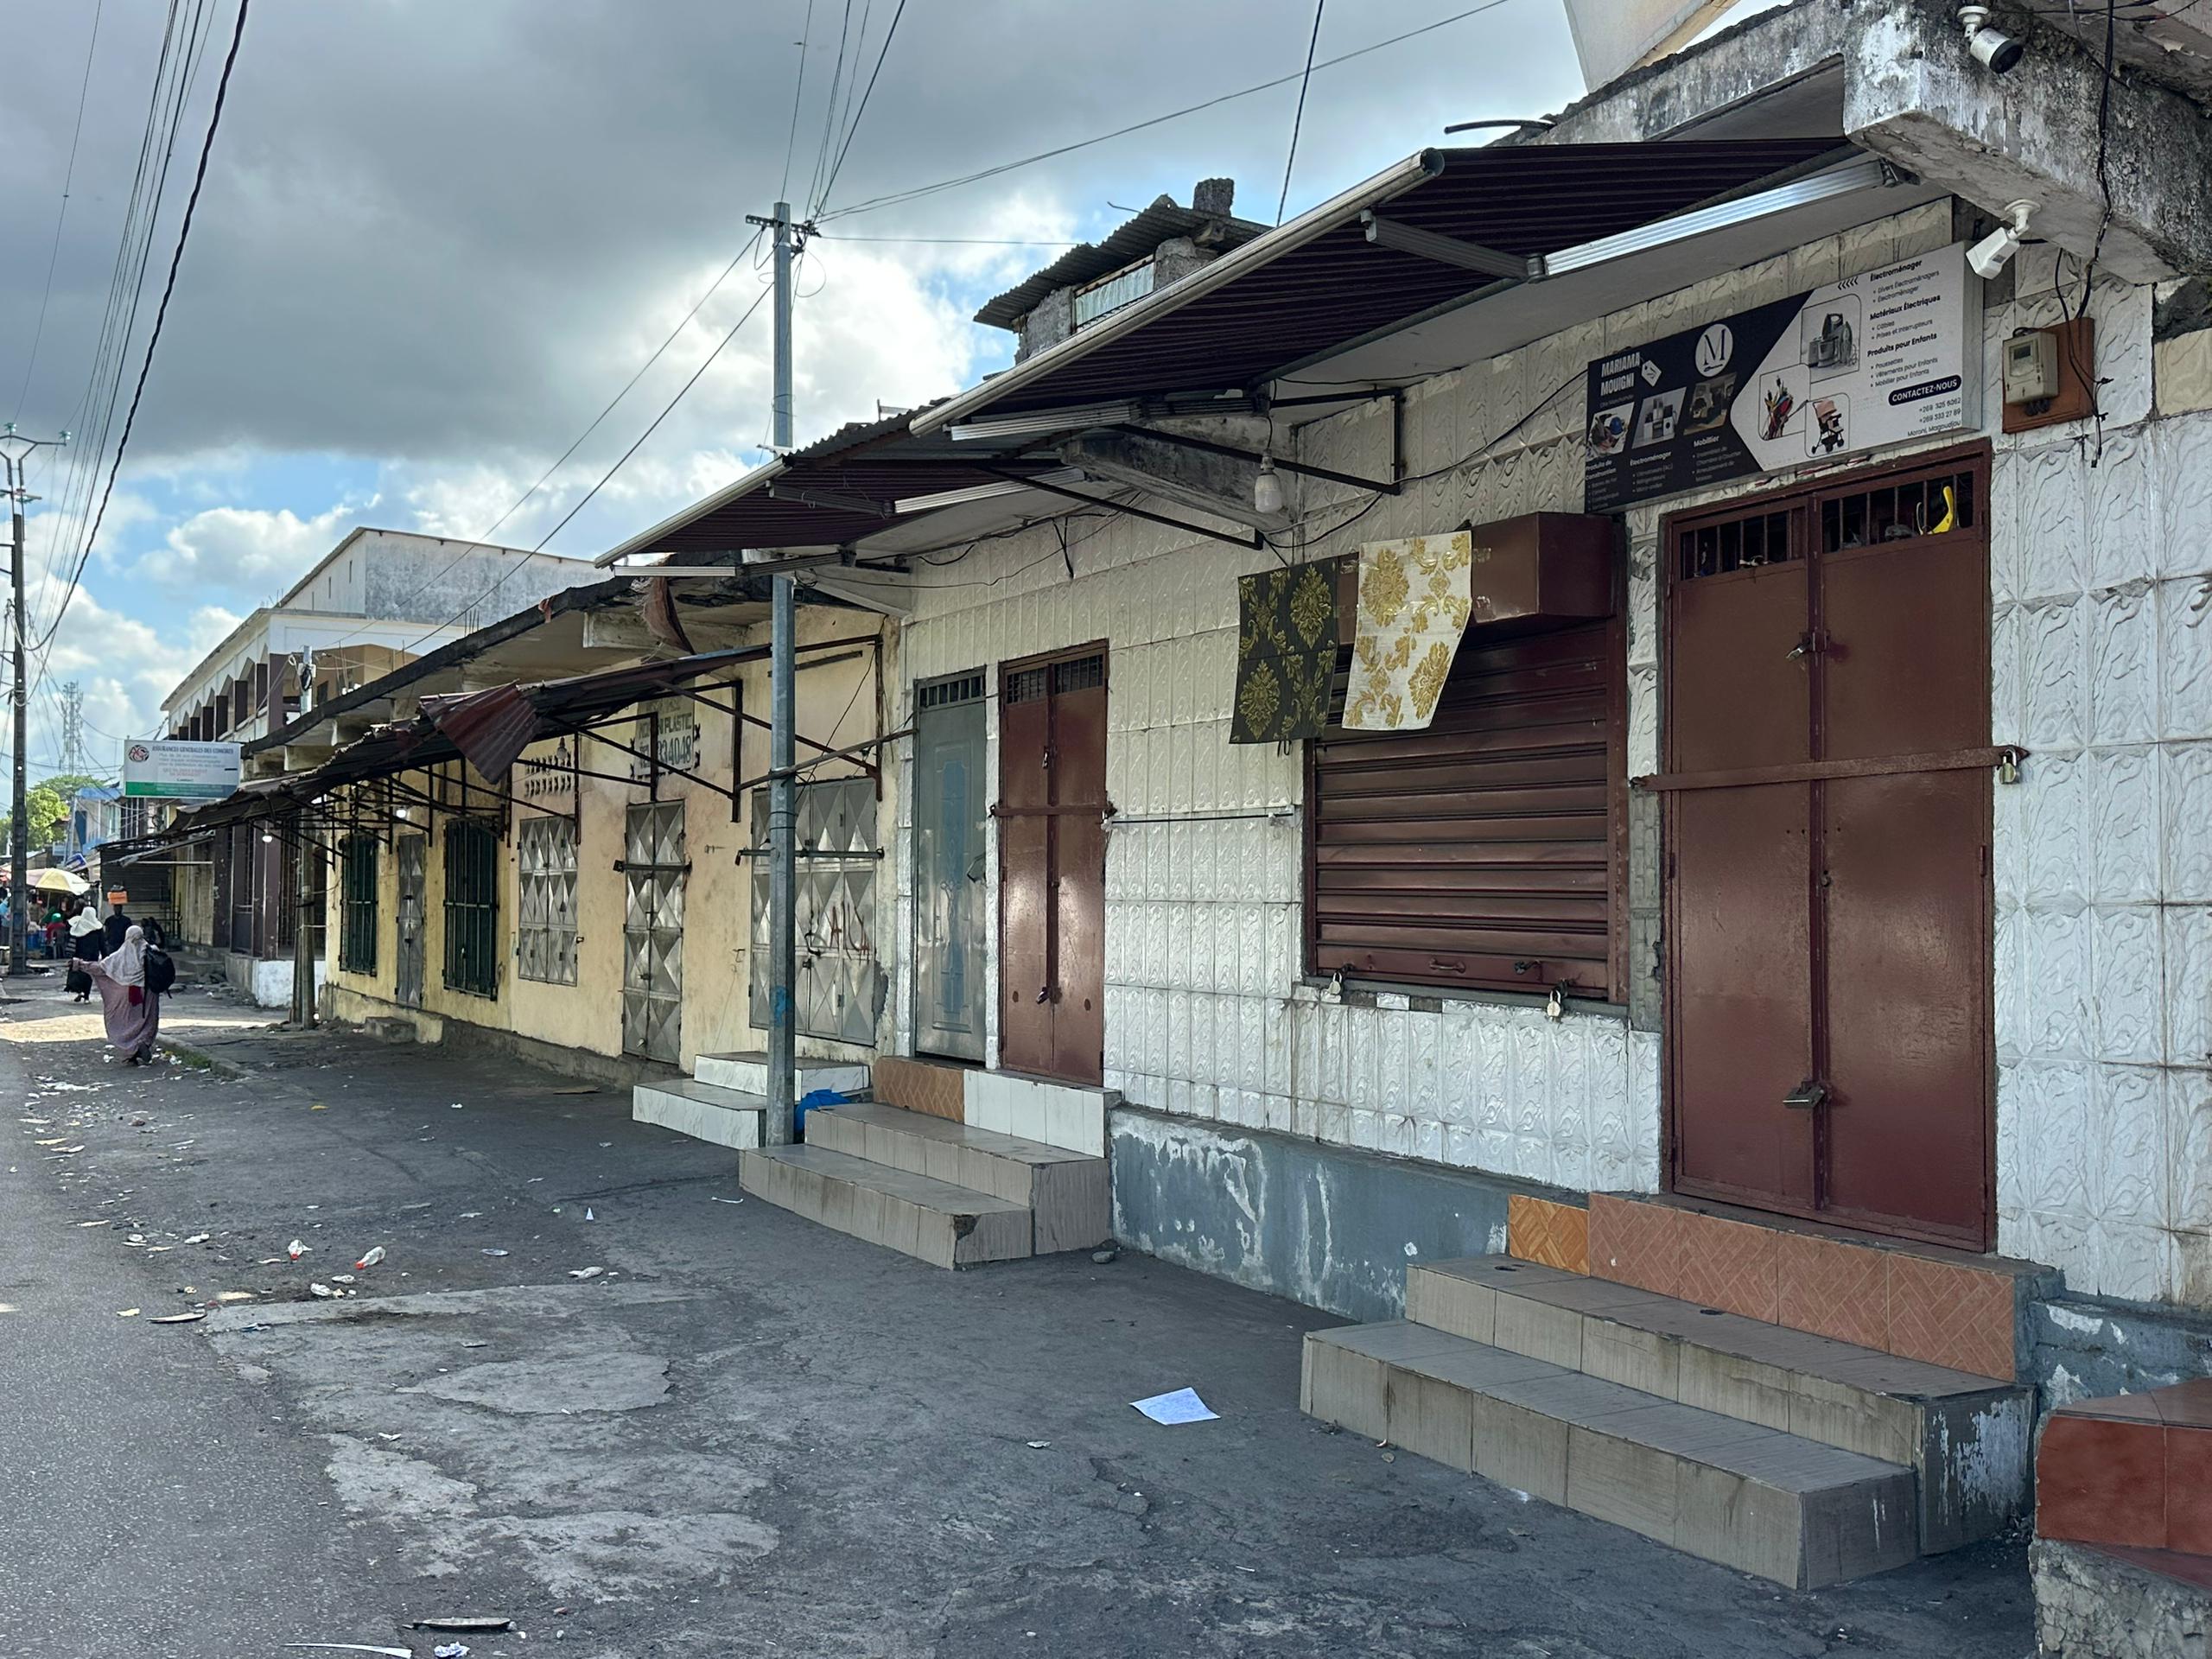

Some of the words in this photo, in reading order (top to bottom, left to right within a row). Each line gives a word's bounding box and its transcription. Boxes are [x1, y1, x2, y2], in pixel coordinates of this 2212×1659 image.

[1870, 260, 1923, 282] Électroménager
[1870, 305, 1903, 321] Matériaux
[1904, 295, 1941, 310] Électriques
[1703, 327, 1727, 365] M
[1867, 343, 1894, 357] Produits
[1895, 340, 1911, 352] pour
[1911, 333, 1937, 346] Enfants
[1601, 352, 1641, 378] MARIAMA
[1896, 374, 1909, 383] pour
[1909, 369, 1929, 378] Enfants
[1904, 363, 1917, 372] pour
[1917, 357, 1938, 367] Enfants
[1600, 372, 1635, 396] MOUIGNI
[1891, 378, 1958, 402] CONTACTEZ-NOUS
